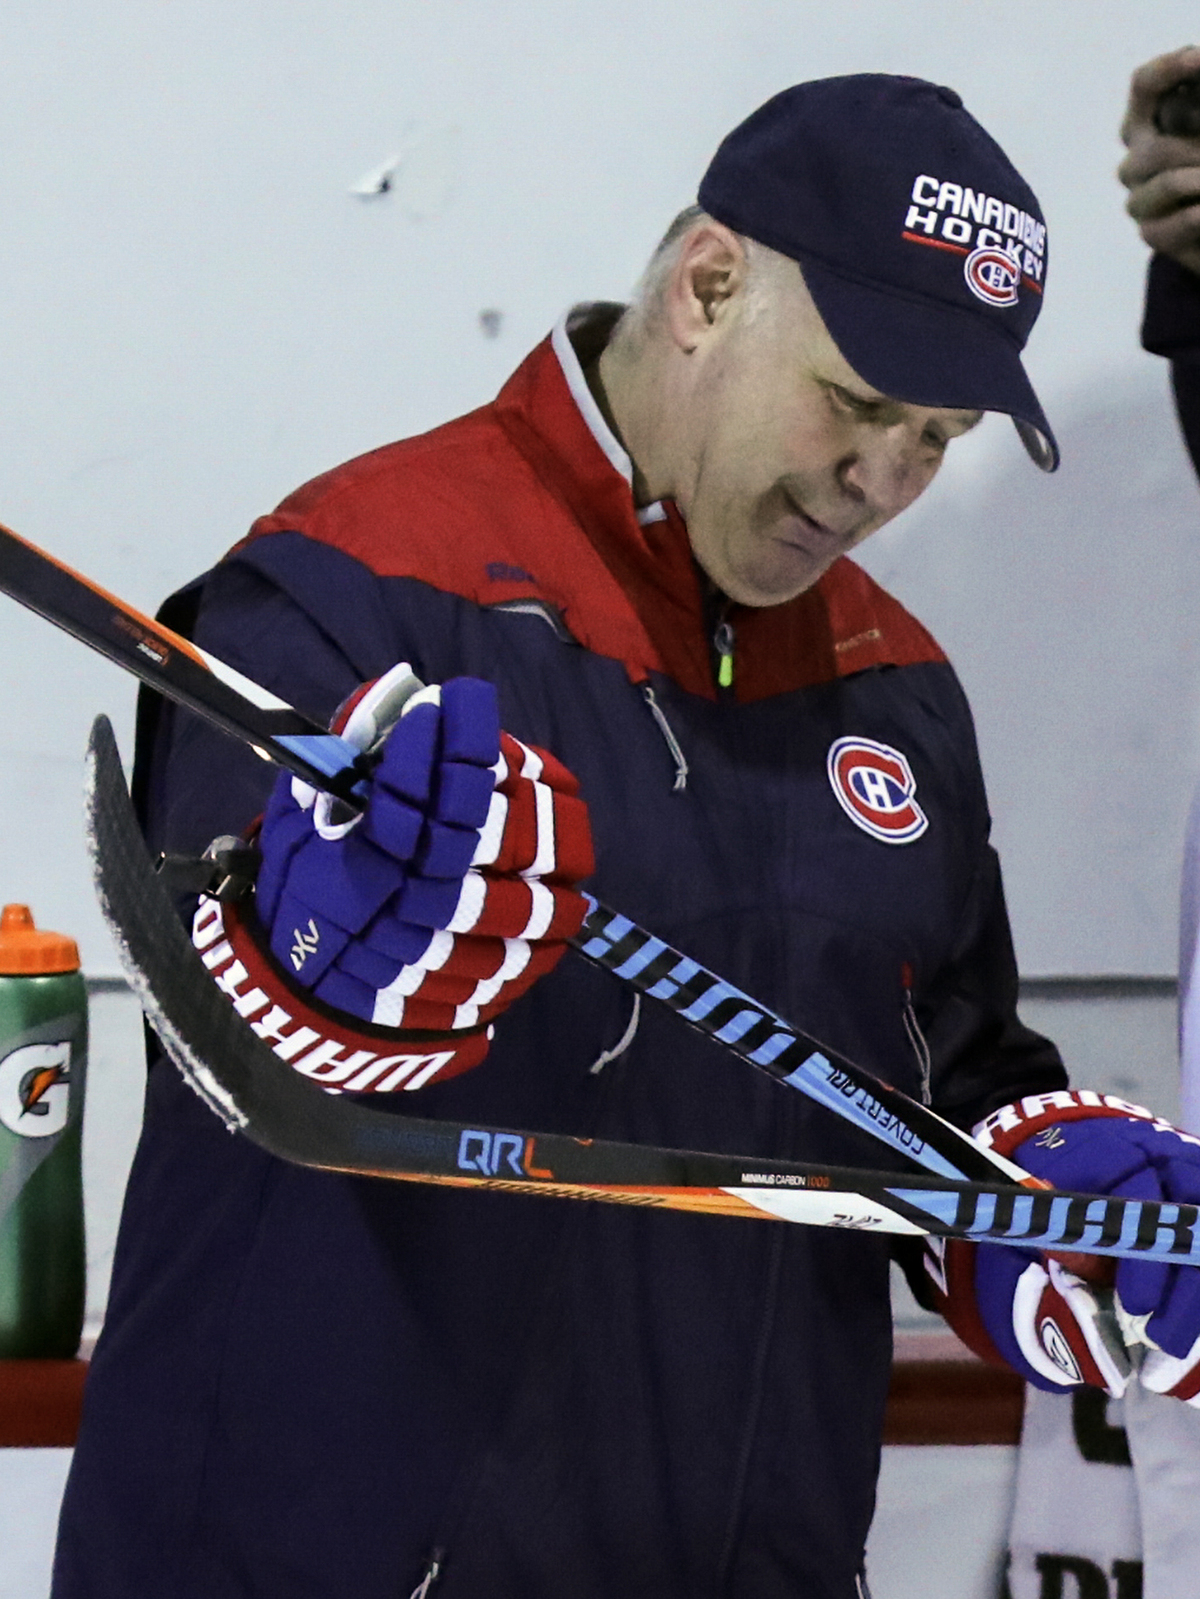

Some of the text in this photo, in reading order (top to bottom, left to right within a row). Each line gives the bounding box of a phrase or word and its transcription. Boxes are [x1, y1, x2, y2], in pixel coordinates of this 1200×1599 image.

[904, 205, 1044, 281] HOCKEY
[911, 173, 1047, 257] CANADIENS
[457, 1128, 554, 1180] QRL
